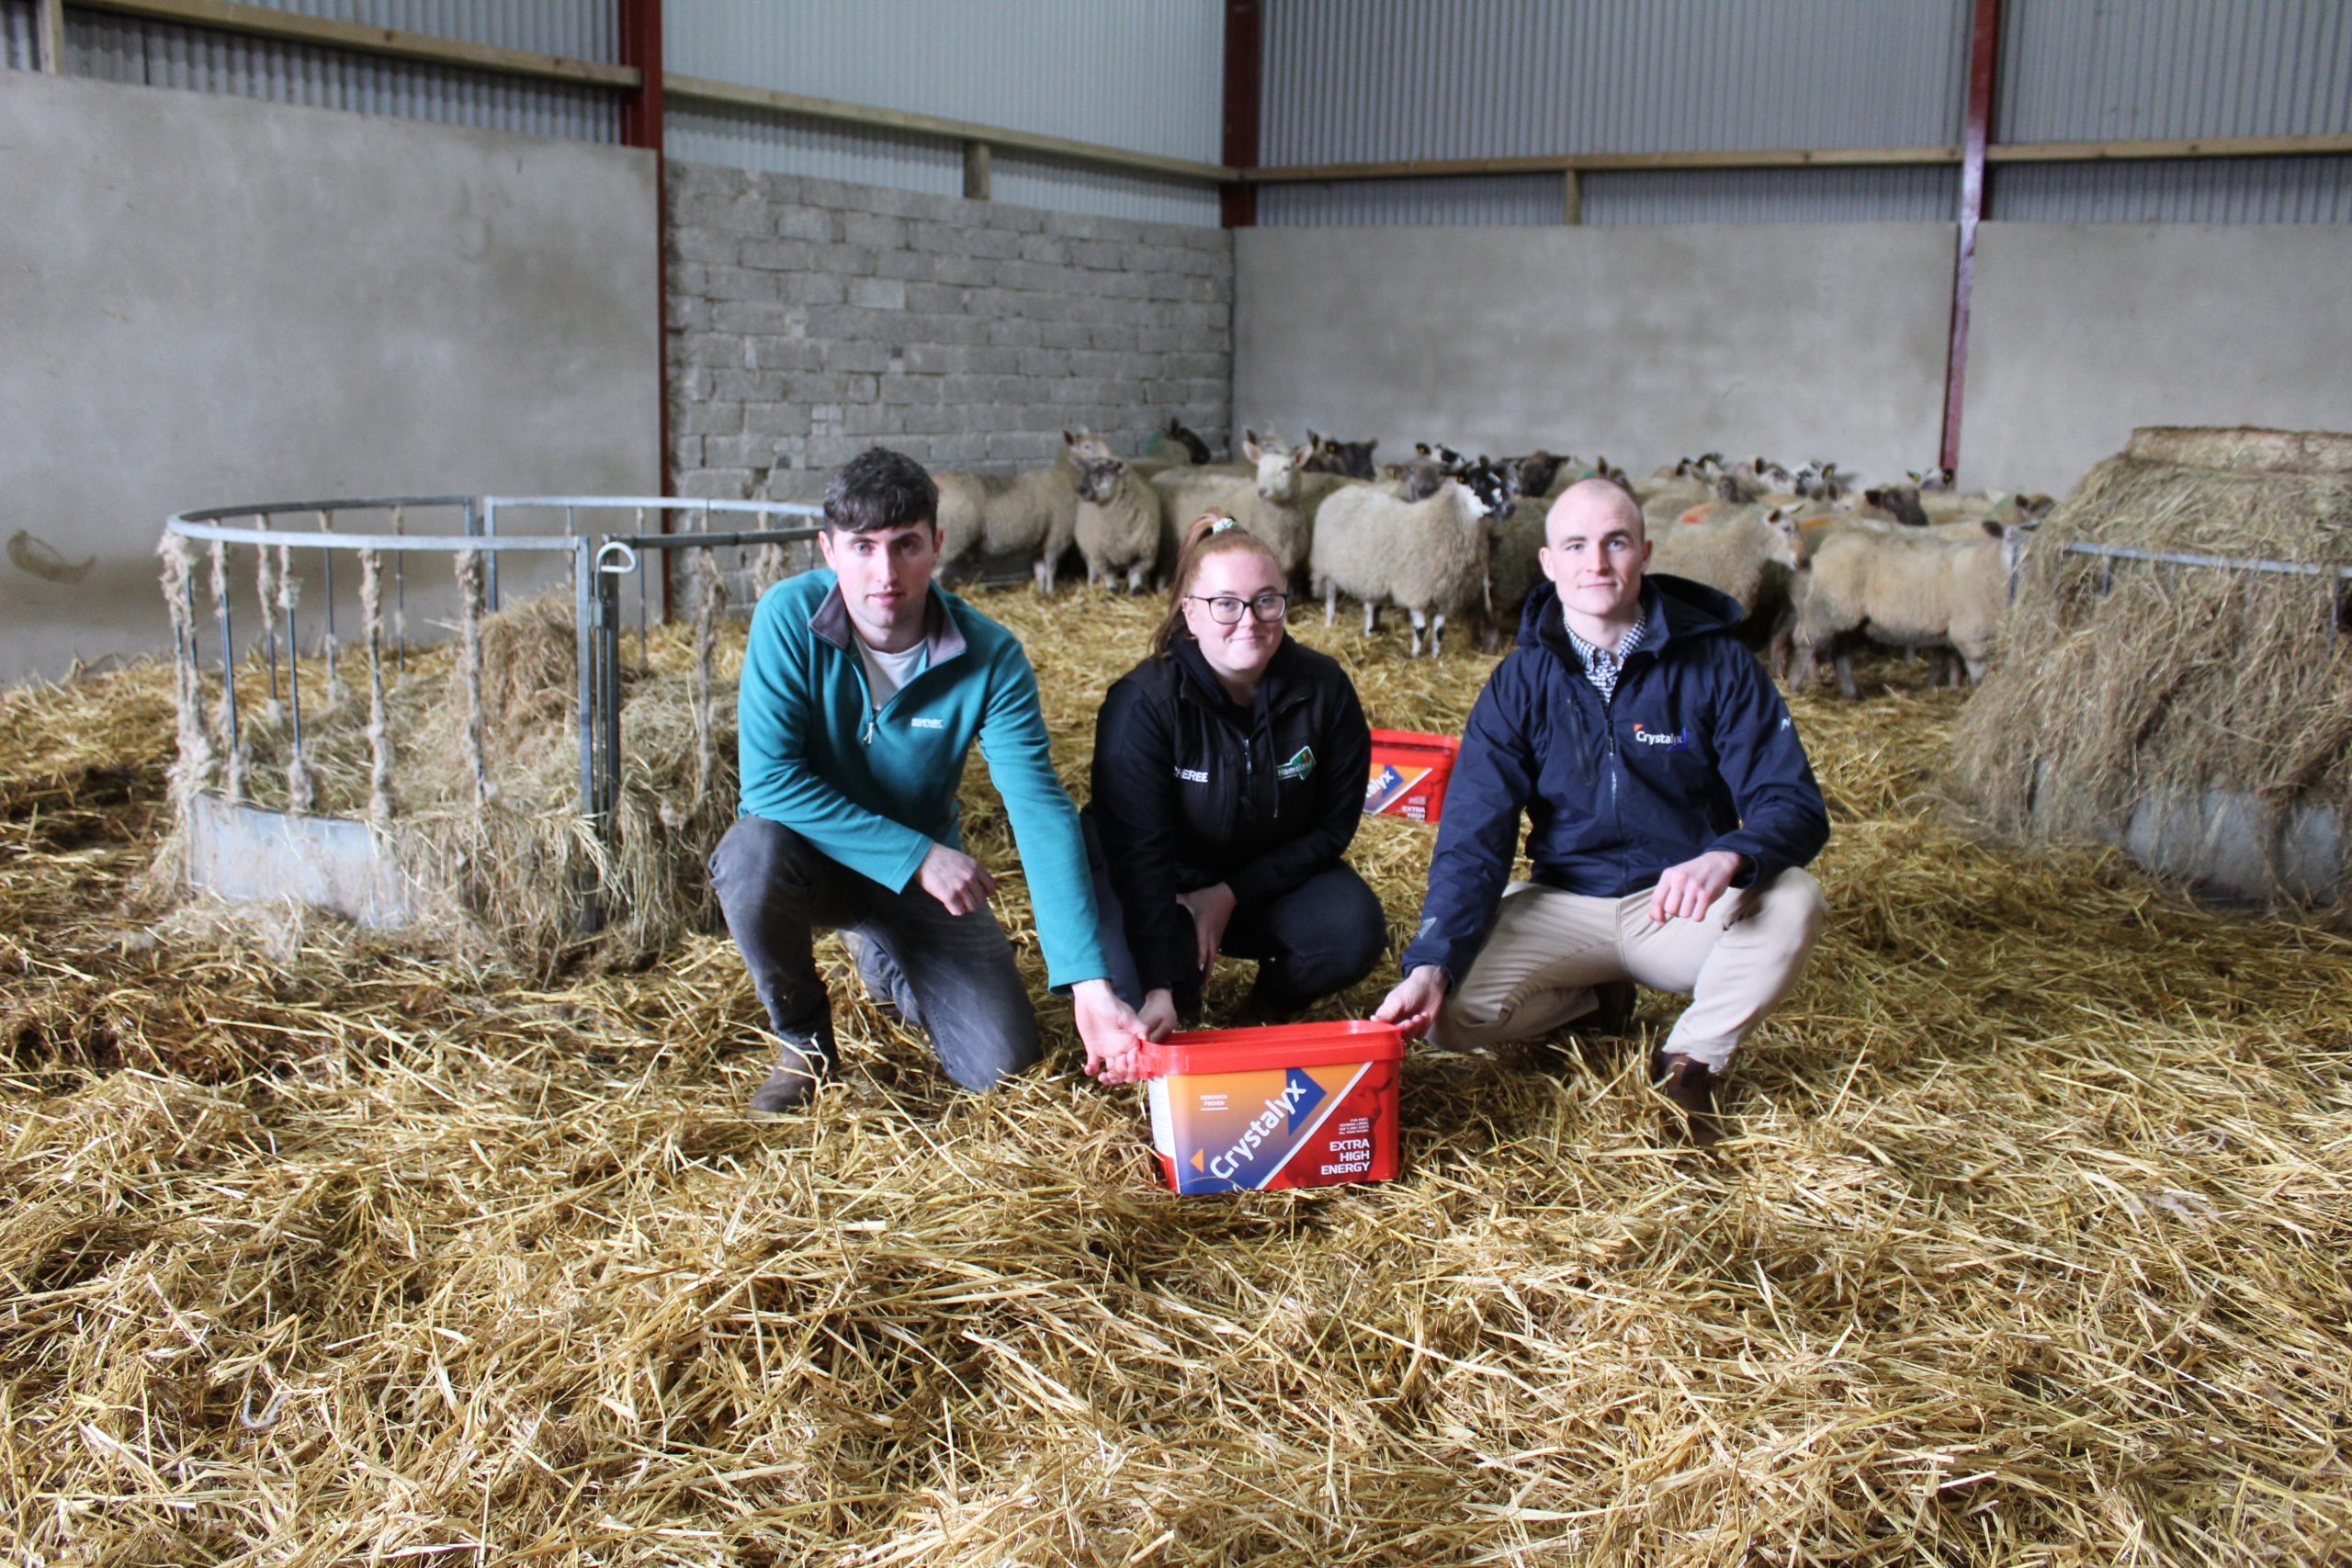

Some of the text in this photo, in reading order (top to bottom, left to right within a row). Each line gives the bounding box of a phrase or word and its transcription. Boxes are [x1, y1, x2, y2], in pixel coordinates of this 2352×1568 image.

[1635, 730, 1682, 745] Crystalyx
[1210, 1079, 1307, 1179] Crystalyx
[1329, 1138, 1370, 1152] EXTRA
[1340, 1150, 1370, 1162] HIGH
[1321, 1161, 1370, 1176] ENERGY
